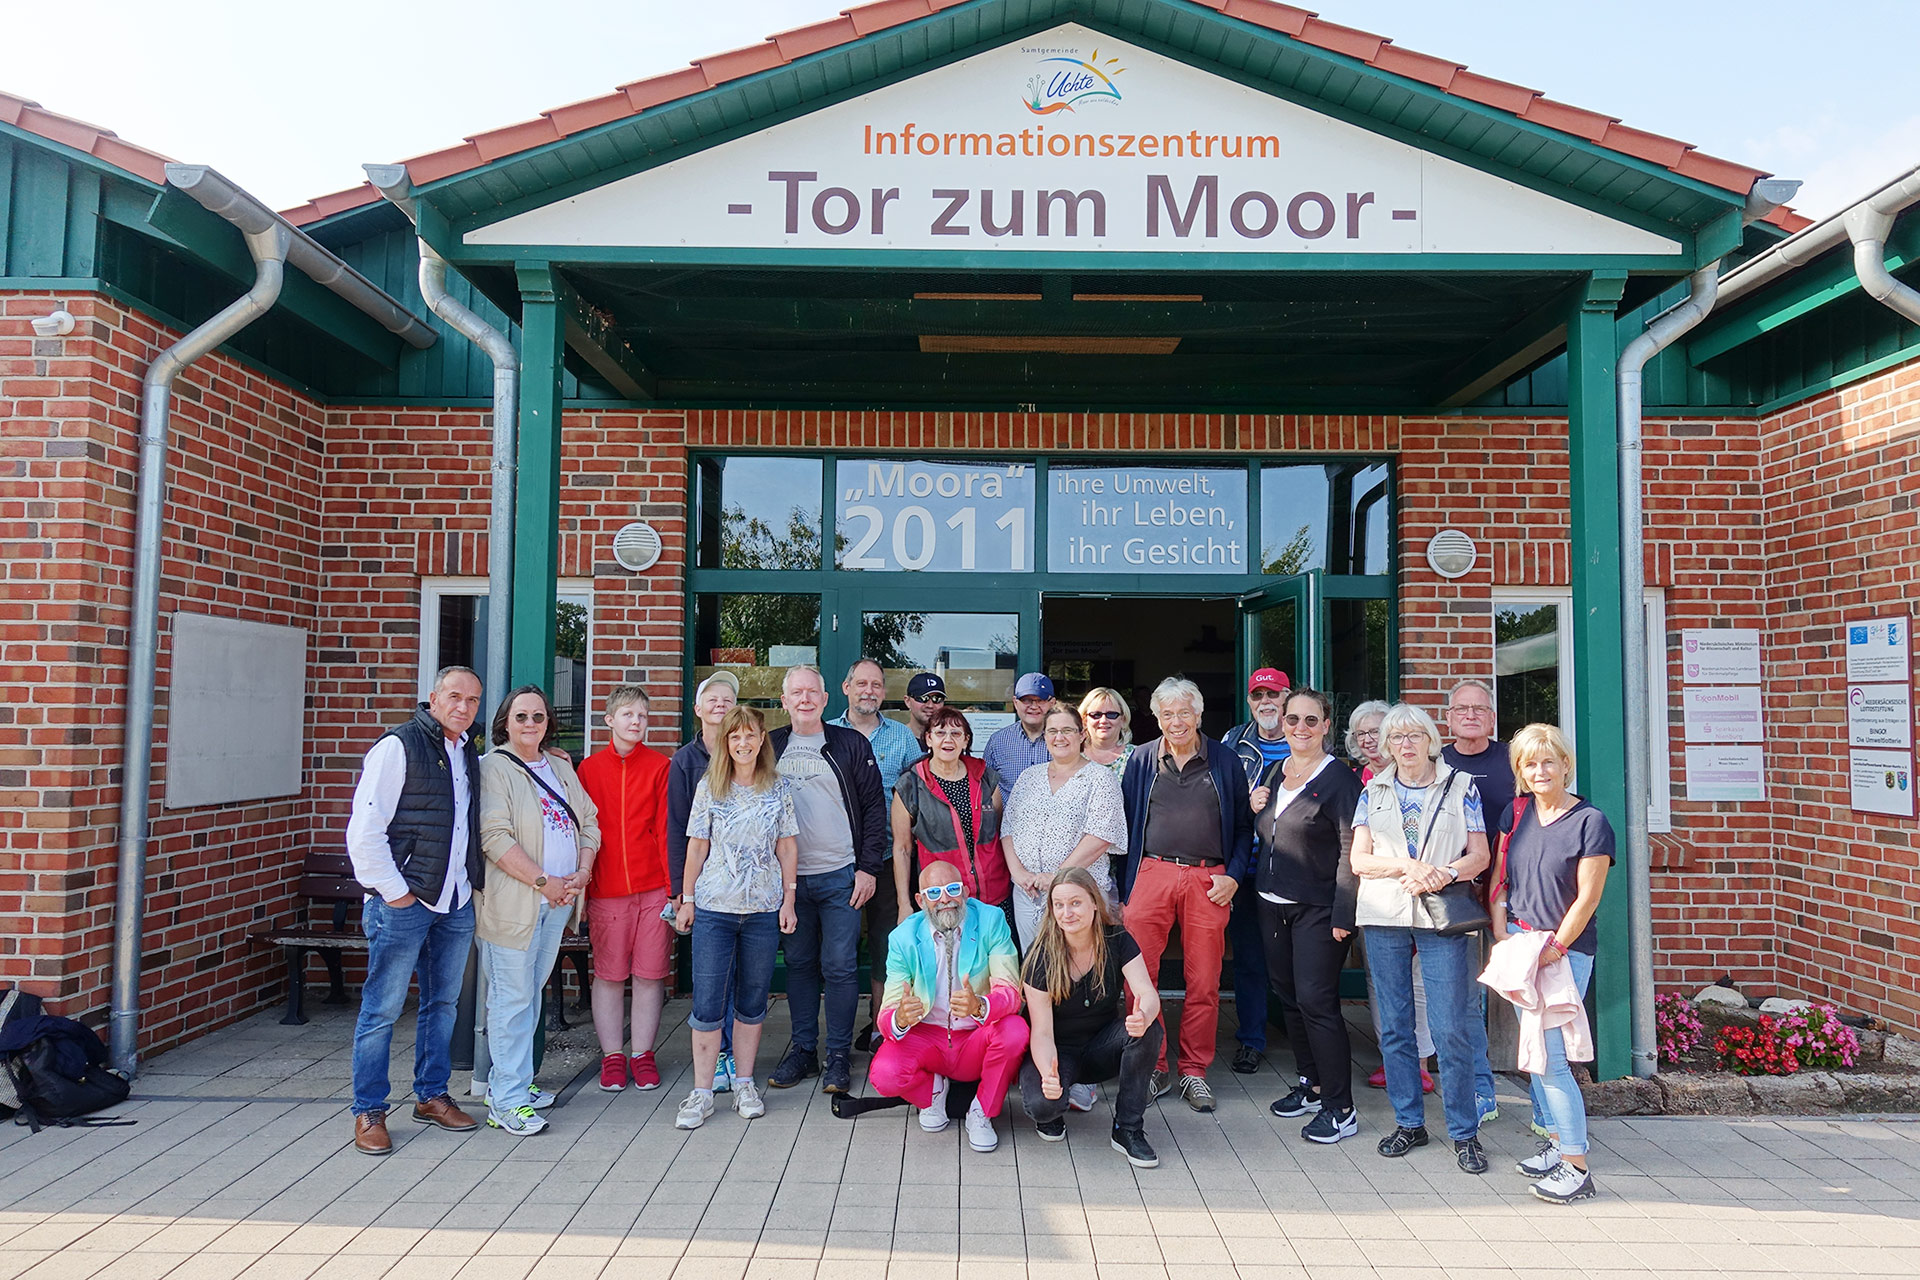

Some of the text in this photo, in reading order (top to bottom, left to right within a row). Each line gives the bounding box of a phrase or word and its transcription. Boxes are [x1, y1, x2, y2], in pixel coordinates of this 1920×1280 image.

[1021, 47, 1079, 55] Samtgemeinde
[1047, 71, 1095, 98] Uchte
[864, 123, 1280, 158] Informationszentrum
[930, 189, 1106, 237] zum
[1057, 472, 1216, 497] ihre Umwelt,
[1082, 500, 1235, 530] ihr Leben,
[842, 505, 1025, 571] 2011
[1069, 537, 1241, 565] ihr Gesicht
[1255, 674, 1274, 682] Gut.
[1695, 694, 1739, 703] ExxonMobil
